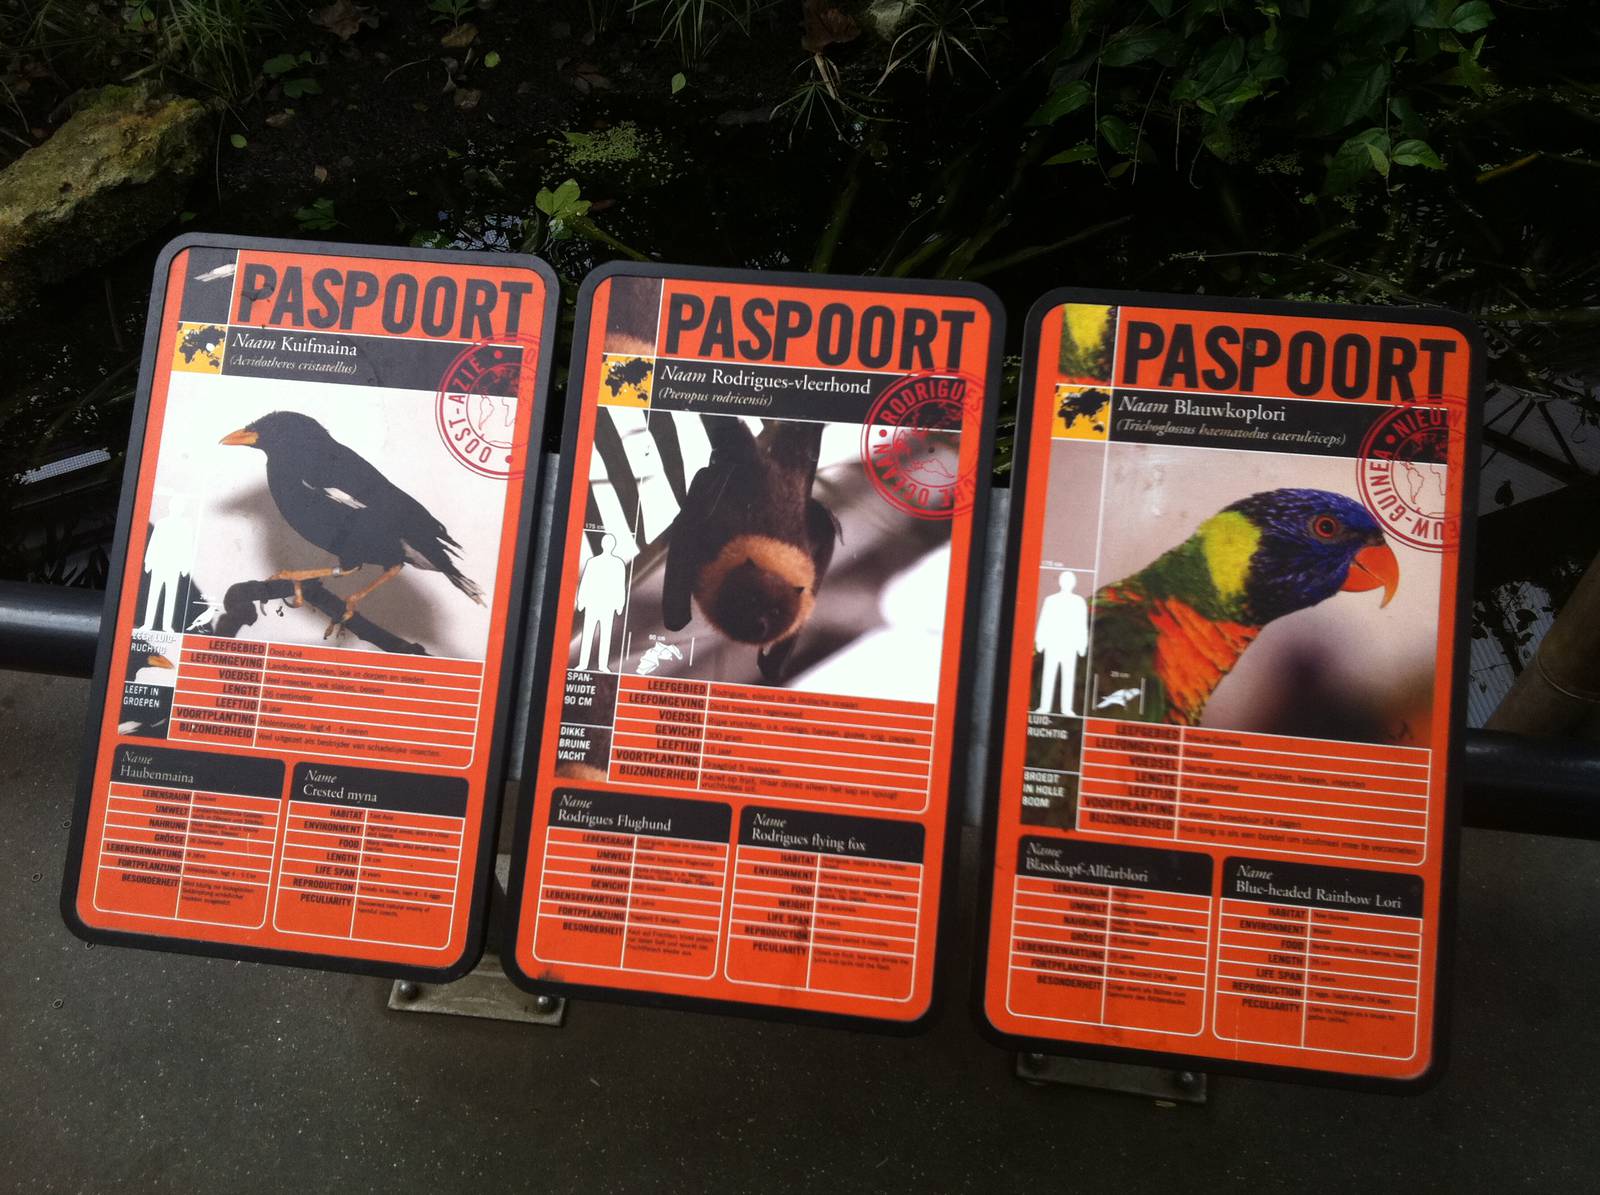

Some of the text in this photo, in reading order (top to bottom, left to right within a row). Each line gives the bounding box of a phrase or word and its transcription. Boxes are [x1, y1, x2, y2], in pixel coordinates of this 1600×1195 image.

[237, 263, 532, 341] PASPOORT
[665, 292, 975, 372] PASPOORT
[232, 333, 357, 356] Naam Kuifmaina
[298, 360, 358, 376] cristatellus)
[1123, 320, 1457, 404] PASPOORT
[660, 365, 871, 394] Naam Rodrigues-vleerhond
[658, 388, 773, 407] (Pteropus rodricensis)
[1118, 397, 1286, 423] Naam Blauwkoplori
[208, 640, 264, 654] LEEFGEBIED
[190, 652, 262, 668] LEEFOMGEVING
[218, 669, 260, 682] VOEDSEL
[567, 672, 593, 682] SPAN-
[124, 685, 160, 696] LEEFT IN
[222, 683, 259, 696] LENGTE
[566, 684, 596, 695] WIJDTE
[647, 680, 706, 695] LEEFGEBIED
[124, 696, 160, 708] GROEPEN
[215, 696, 257, 710] LEEFTIJD
[564, 696, 593, 706] 90 CM
[628, 693, 704, 709] LEEFOMGEVING
[175, 707, 255, 724] VOORTPLANTING
[658, 710, 703, 723] VOEDSEL
[178, 722, 253, 738] BIJZONDERHEID
[560, 726, 585, 737] DIKKE
[654, 724, 701, 738] GEWICHT
[1027, 727, 1068, 740] RUCHTIG
[559, 738, 591, 750] BRUINE
[656, 739, 700, 752] LEEFTIJD
[122, 750, 153, 765] Name
[558, 750, 586, 761] VACHT
[615, 749, 698, 766] VOORTPLANTING
[1128, 755, 1177, 770] VOEDSEL
[120, 765, 195, 784] Haubenmaina
[304, 770, 338, 784] Name
[618, 764, 697, 781] BIJZONDERHEID
[1024, 772, 1059, 783] BROEDT
[1134, 770, 1176, 785] LENGTE
[142, 789, 190, 801] LEBENSRAUM
[303, 784, 378, 804] Crested myna
[1023, 784, 1064, 797] IN HOLLE
[560, 794, 592, 808] Name
[155, 805, 188, 815] UMWELT
[330, 808, 362, 819] HABITAT
[148, 818, 186, 829] NAHRUNG
[558, 808, 672, 832] Rodrigues Flughund
[753, 812, 788, 827] Name
[303, 821, 360, 834] ENVIRONMENT
[338, 839, 359, 848] FOOD
[582, 833, 633, 846] LEBENSRAUM
[752, 828, 866, 851] Rodrigues flying fox
[106, 842, 182, 858] LEBENSERWARTUNG
[1027, 842, 1062, 857] Name
[326, 852, 357, 862] LENGTH
[117, 858, 180, 872] FORTPFLANZUNG
[315, 865, 355, 877] LIFE SPAN
[590, 864, 629, 876] NAHRUNG
[753, 865, 813, 879] ENVIRONMENT
[1236, 864, 1274, 880] Name
[121, 873, 178, 887] BESONDERHEIT
[293, 877, 353, 892] REPRODUCTION
[590, 879, 628, 890] GEWICHT
[545, 889, 626, 905] LEBENSERWARTUNG
[791, 885, 812, 895] FOOD
[1236, 880, 1402, 908] Blue-headed Rainbow Lori
[300, 893, 351, 907] PECULIARITY
[778, 898, 811, 909] WEIGHT
[558, 906, 624, 920] FORTPFLANZUNG
[767, 912, 809, 925] LIFE SPAN
[1268, 907, 1305, 918] HABITAT
[562, 921, 623, 936] BESONDERHEIT
[1239, 919, 1305, 934] ENVIRONMENT
[752, 941, 806, 956] PECULIARITY
[1281, 939, 1304, 950] FOOD
[1267, 953, 1303, 965] LENGTH
[1256, 968, 1302, 981] LIFE SPAN
[1242, 998, 1299, 1012] PECULIARITY
